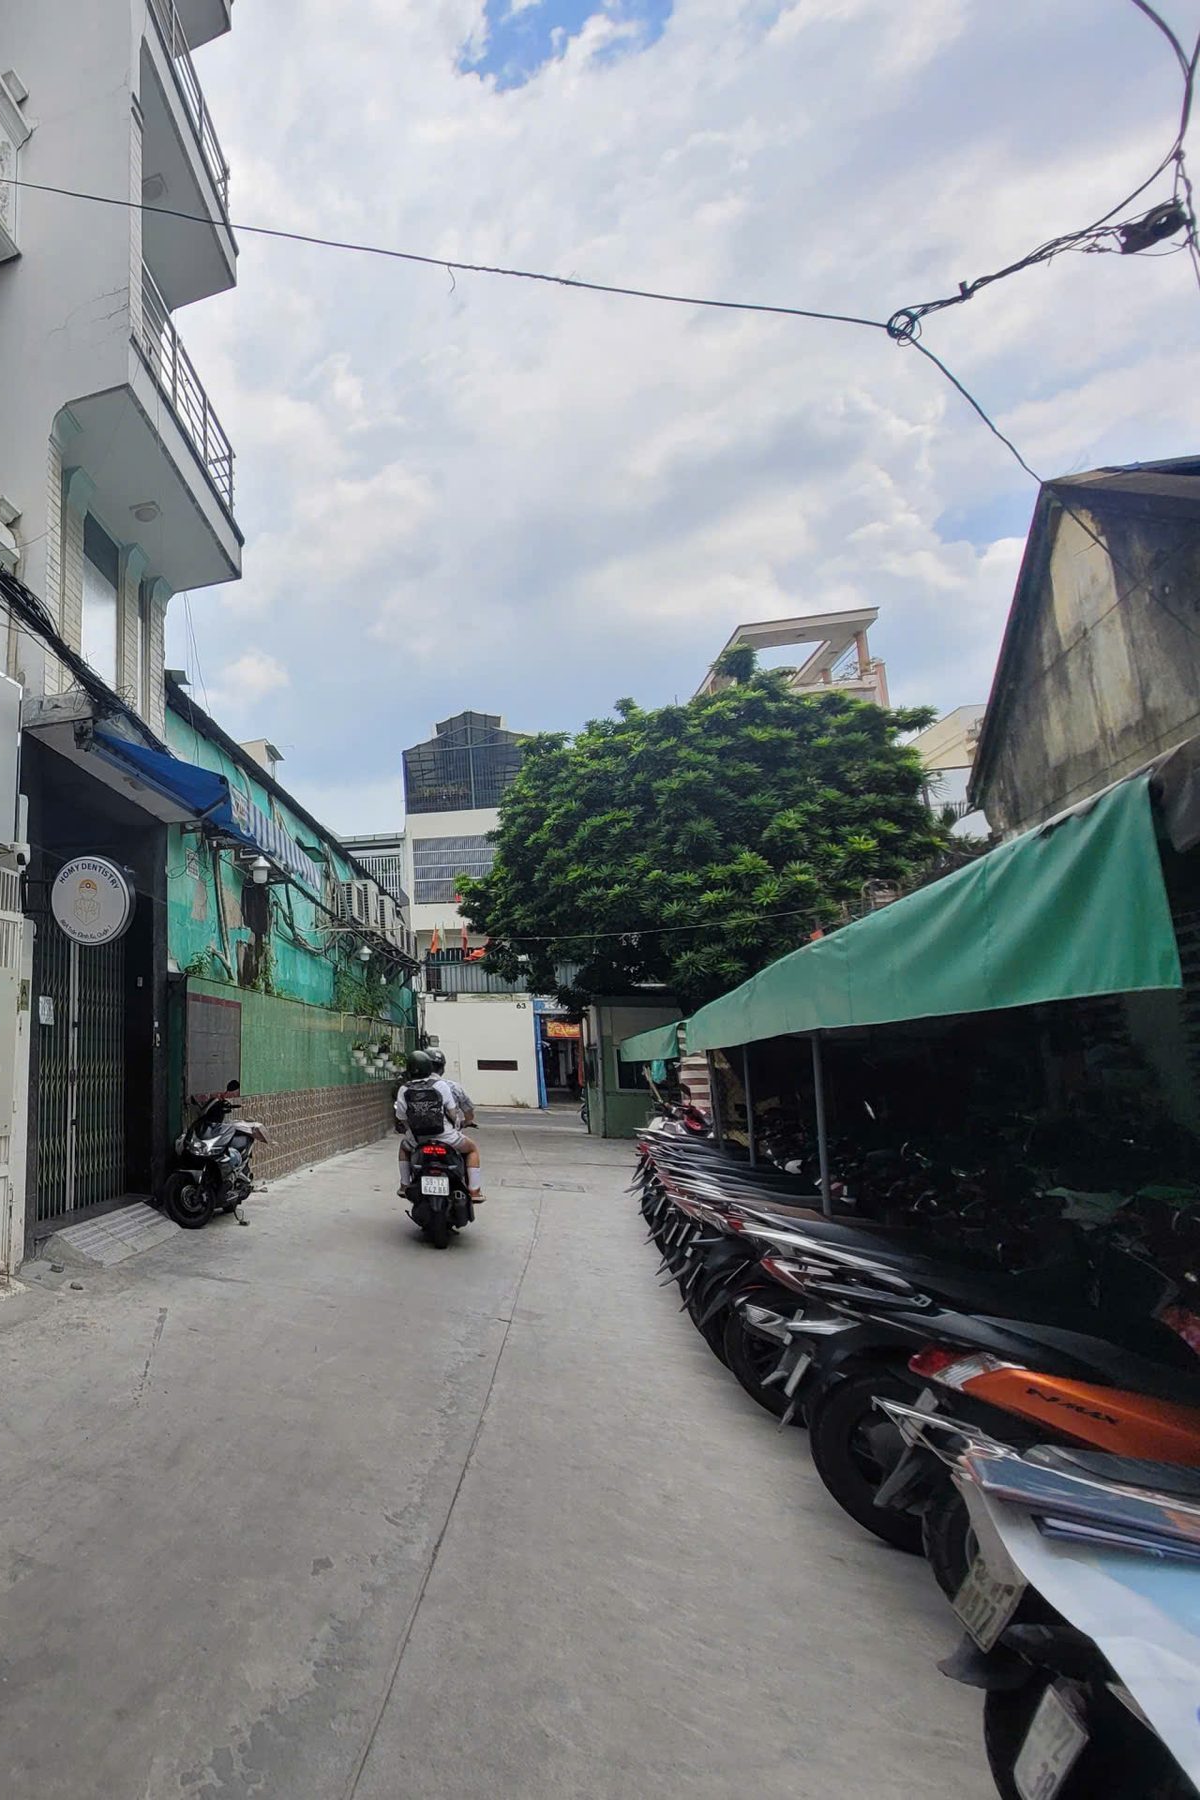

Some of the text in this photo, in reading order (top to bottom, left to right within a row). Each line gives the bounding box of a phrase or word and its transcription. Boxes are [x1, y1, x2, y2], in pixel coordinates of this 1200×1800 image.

[59, 862, 120, 890] HOMY DENTISTRY
[516, 1002, 527, 1010] 63
